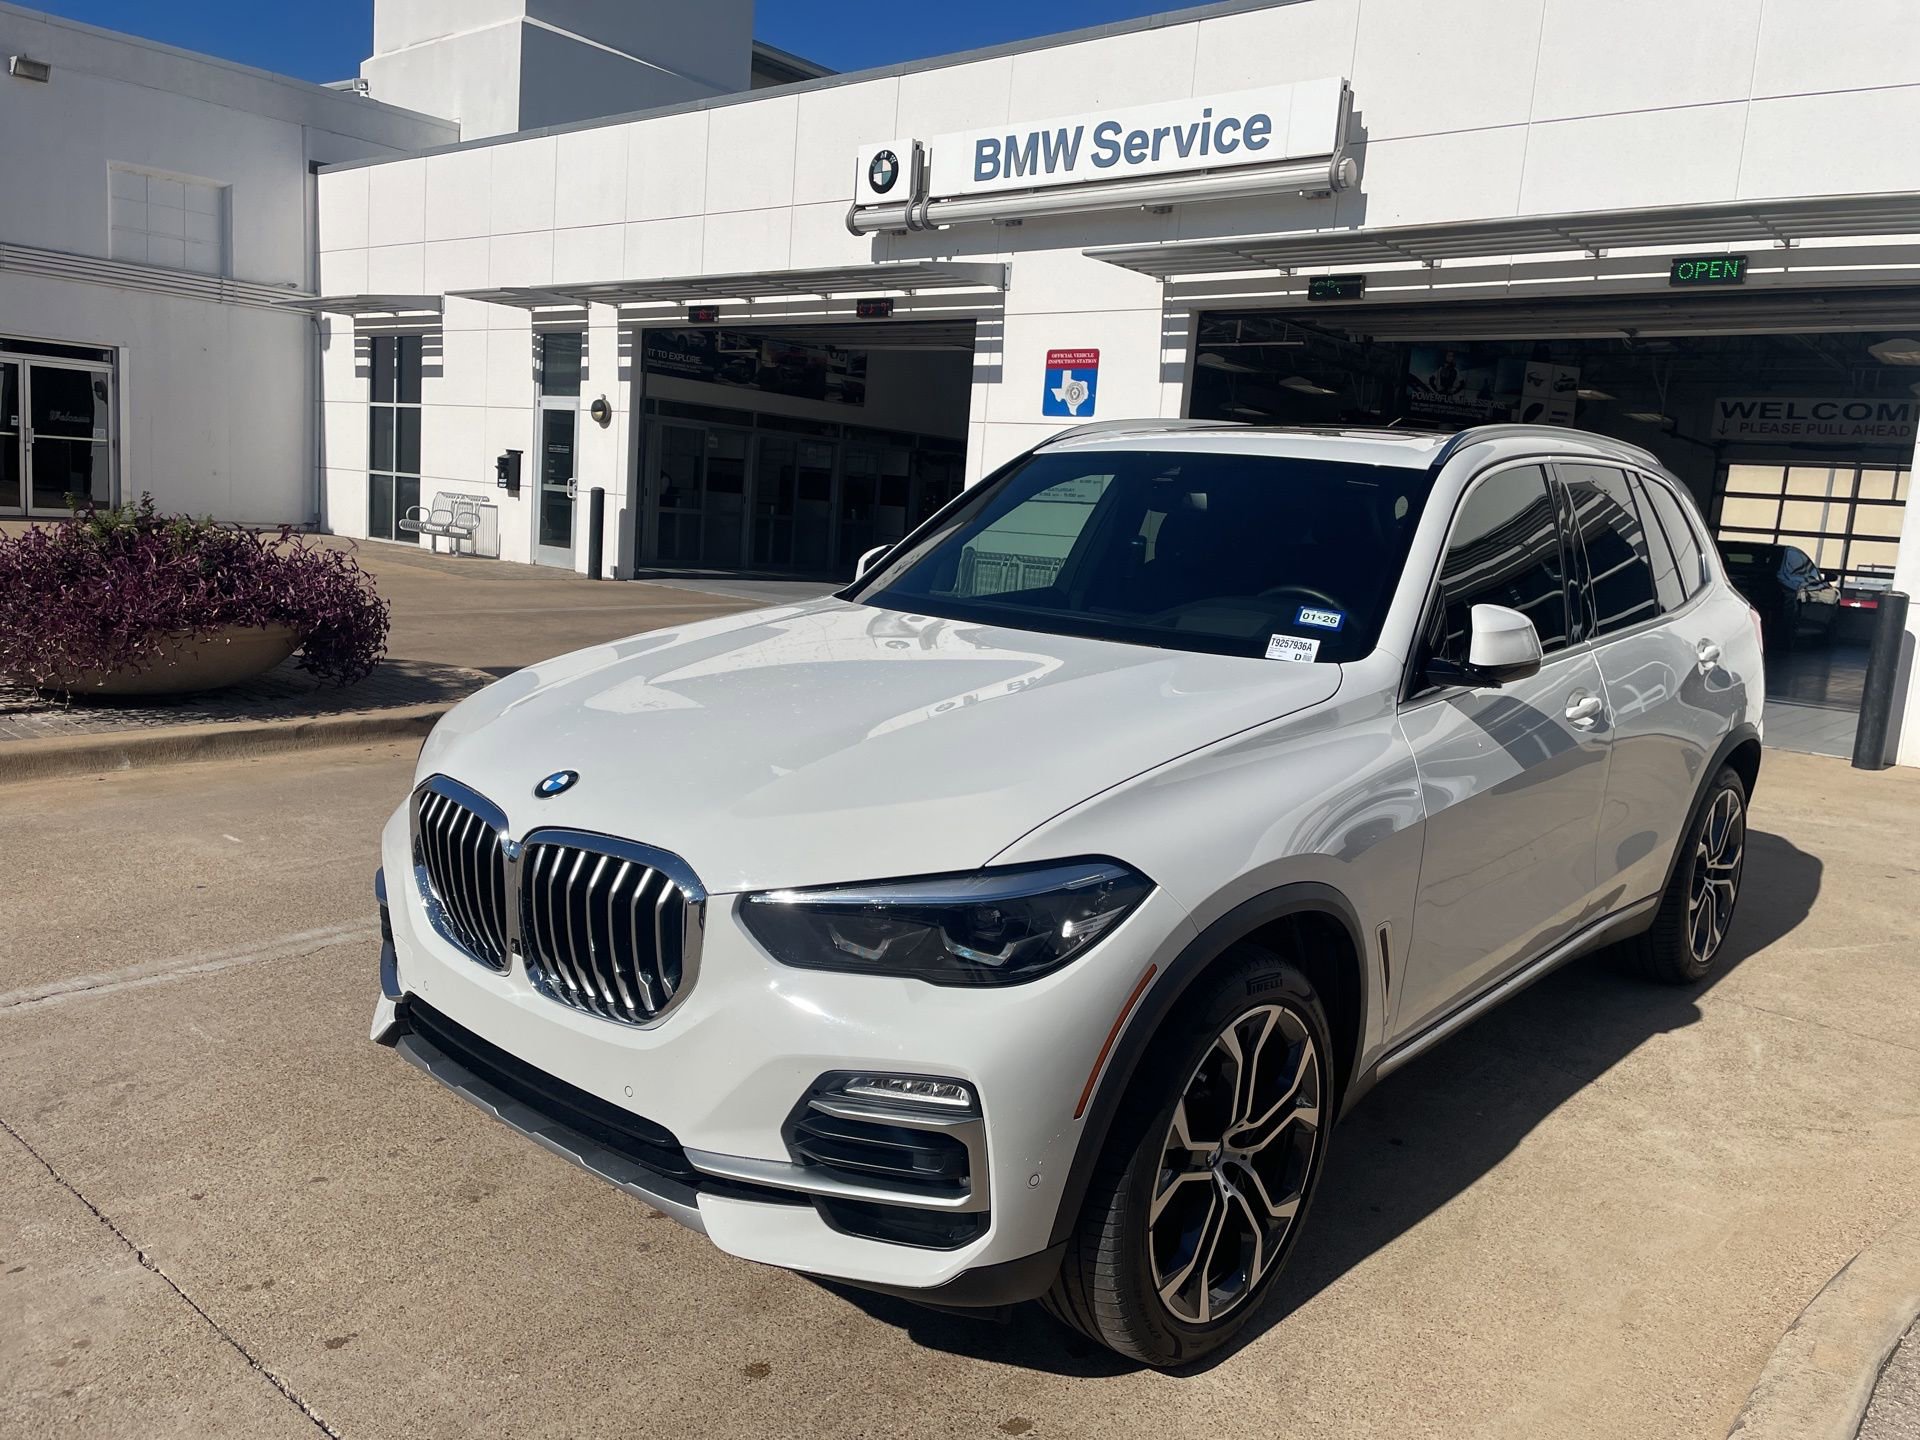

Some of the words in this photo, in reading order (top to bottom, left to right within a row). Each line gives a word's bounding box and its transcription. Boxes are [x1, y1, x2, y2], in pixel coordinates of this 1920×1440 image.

[974, 126, 1085, 182] BMW
[1090, 107, 1272, 169] Service
[1677, 260, 1739, 280] OPEN
[1720, 402, 1918, 421] WELCOM
[1739, 422, 1801, 436] PLEASE
[1805, 423, 1847, 437] PULL
[1851, 424, 1911, 438] AHEAD
[1271, 638, 1312, 652] T9257936A
[1246, 972, 1283, 995] PIRELLI
